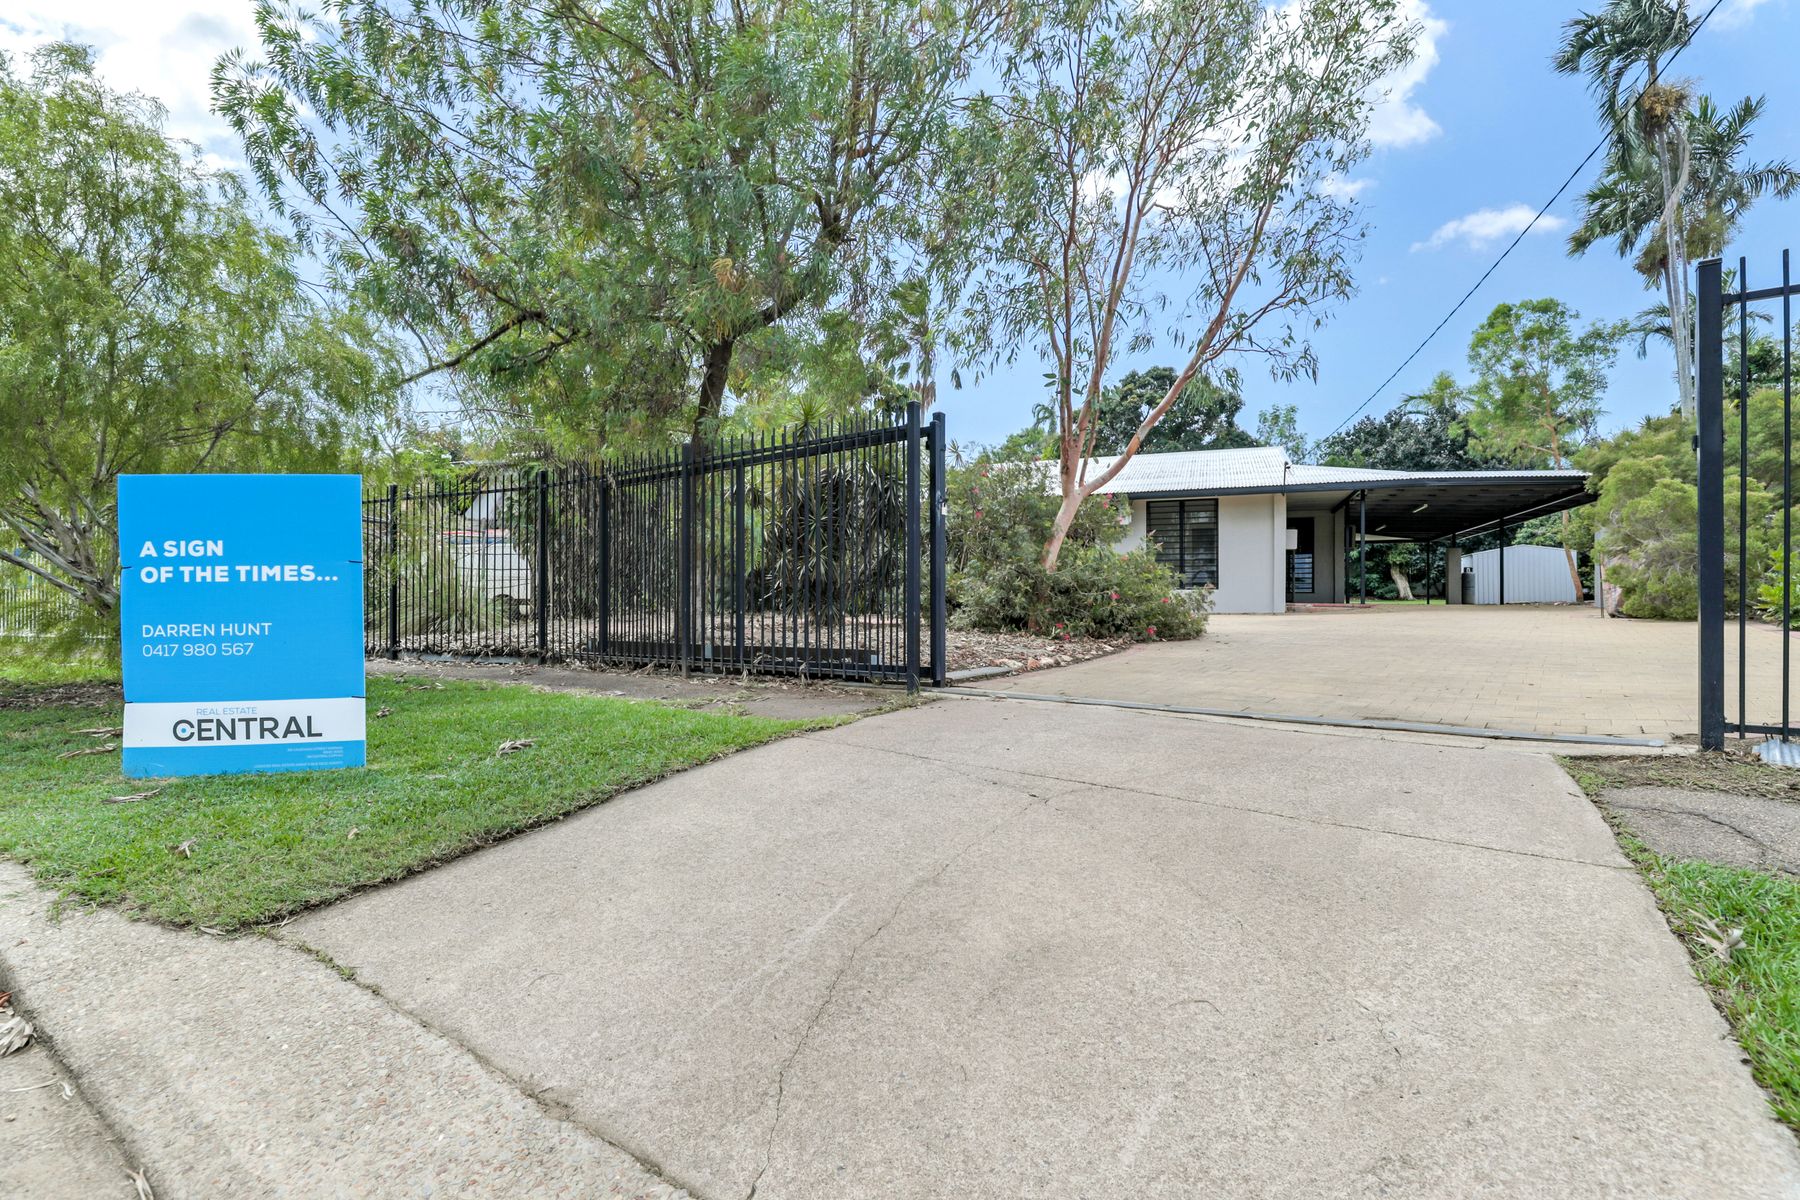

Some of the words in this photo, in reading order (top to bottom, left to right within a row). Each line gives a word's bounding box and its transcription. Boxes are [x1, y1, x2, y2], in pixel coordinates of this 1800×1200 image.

[139, 541, 158, 558] A
[163, 540, 224, 558] SIGN
[140, 566, 173, 584] OF
[179, 565, 230, 582] THE
[235, 564, 339, 582] TIMES...
[142, 623, 215, 638] DARREN
[221, 622, 272, 636] HUNT
[142, 644, 179, 657] 0417
[182, 643, 217, 657] 980
[221, 642, 254, 656] 567
[196, 707, 220, 716] REAL
[222, 706, 257, 715] ESTATE
[172, 715, 323, 742] CENTRAL
